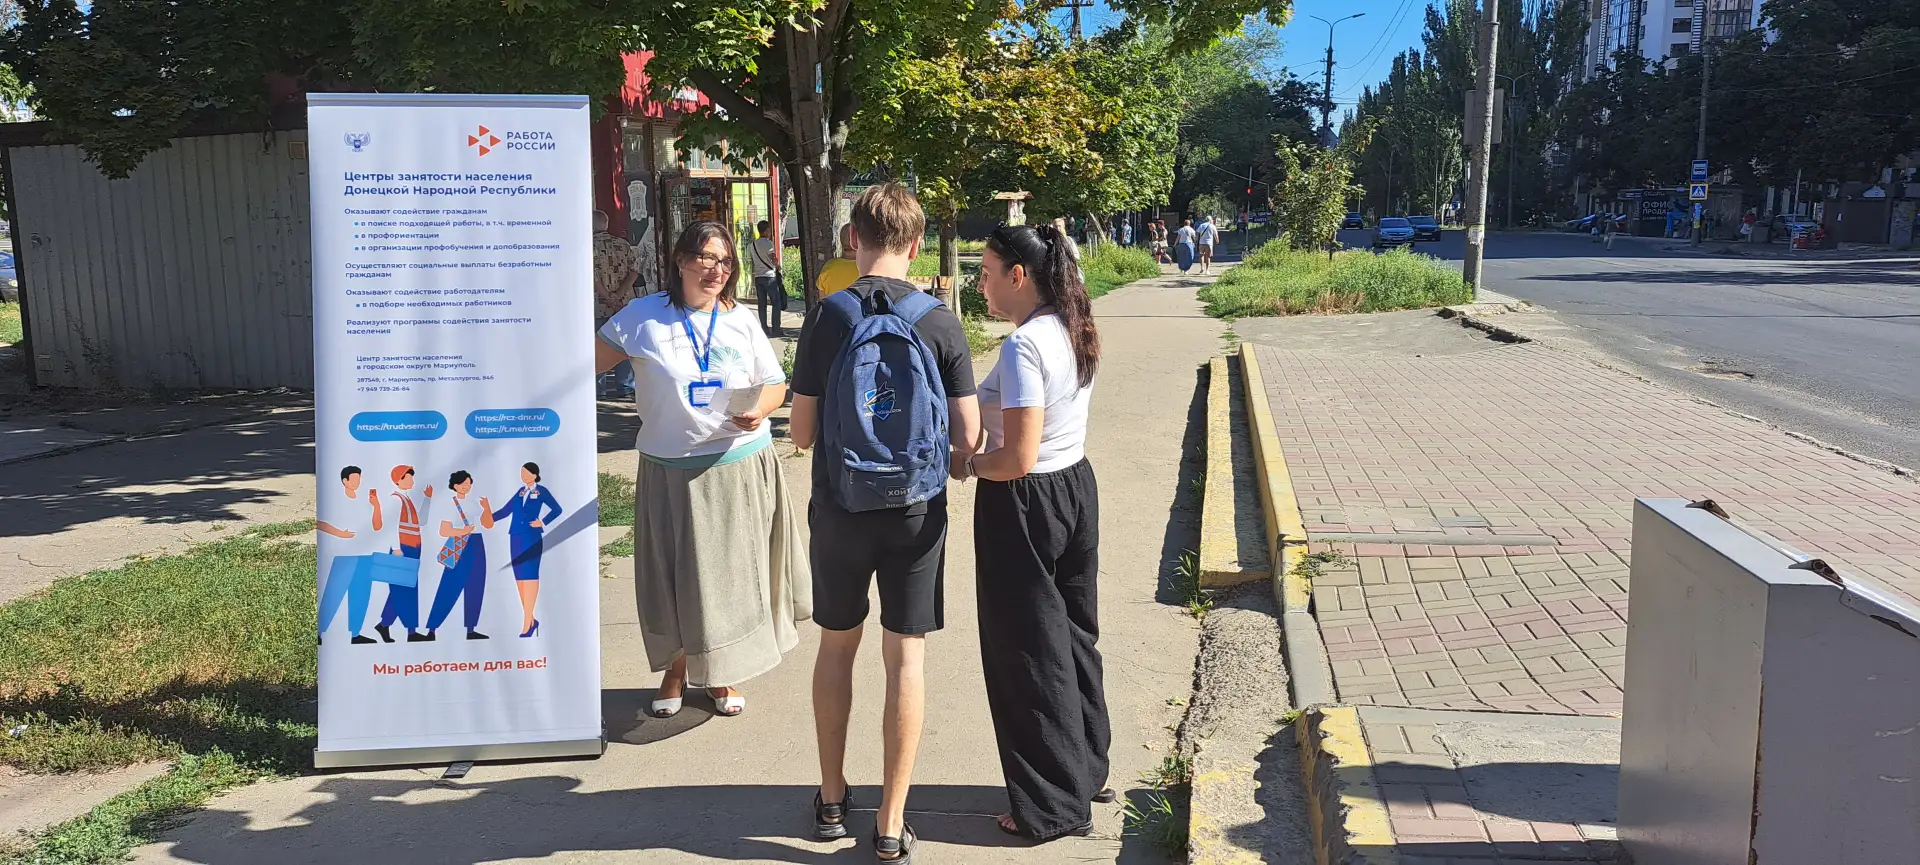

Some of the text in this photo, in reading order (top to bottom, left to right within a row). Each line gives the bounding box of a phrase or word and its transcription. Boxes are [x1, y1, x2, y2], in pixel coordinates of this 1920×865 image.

[507, 131, 553, 140] РАБОТА
[507, 142, 555, 150] РОССИИ
[344, 172, 394, 182] Центры
[344, 185, 556, 196] Донецкой Народной Республики
[475, 413, 545, 423] https://rcz-dnr.ru/
[356, 422, 439, 432] https://trudvsem.ru/
[475, 425, 550, 434] https://t.me/rczdnr
[373, 657, 546, 676] Мы работаем для вас!
